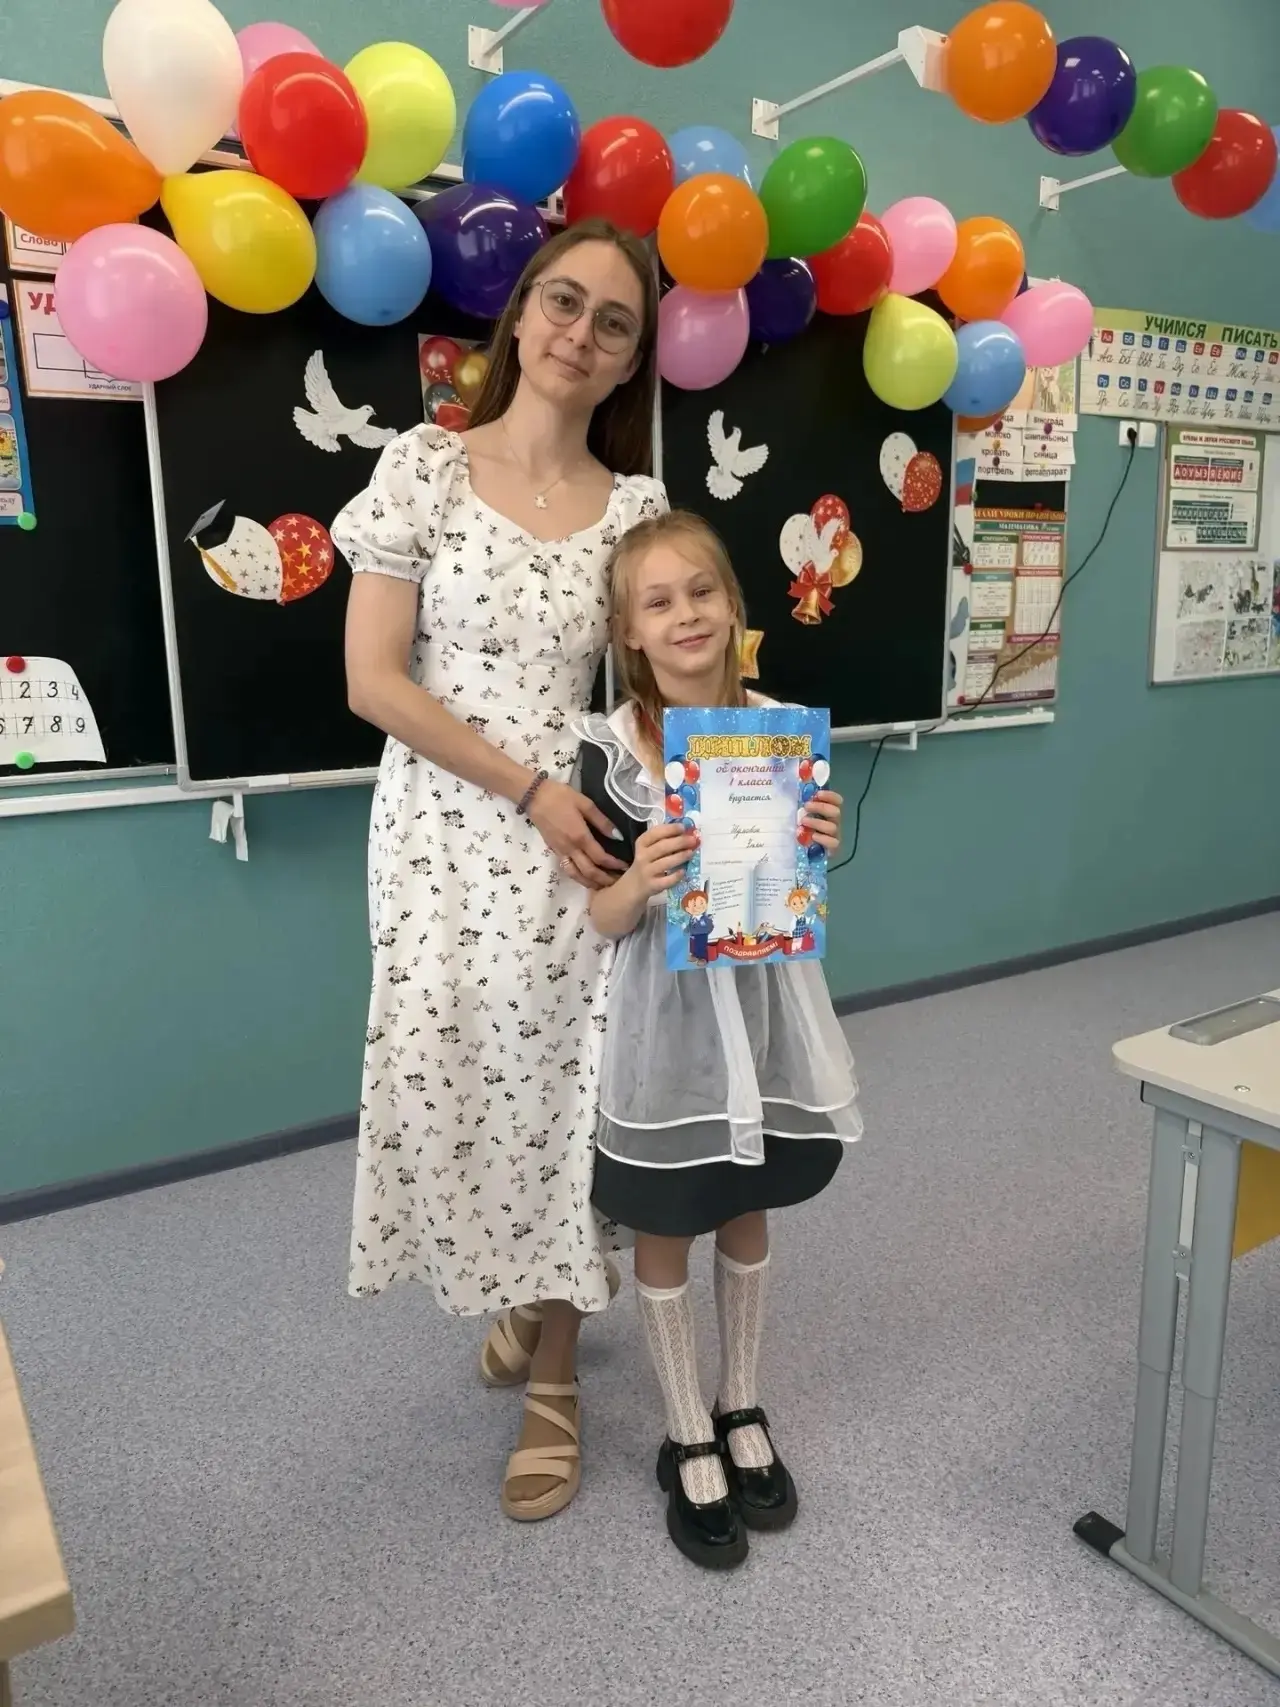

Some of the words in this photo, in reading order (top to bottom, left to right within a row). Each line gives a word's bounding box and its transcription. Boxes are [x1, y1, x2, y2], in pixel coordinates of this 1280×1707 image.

[1144, 315, 1207, 339] УЧИМСЯ
[1221, 327, 1278, 349] ПИСАТЬ
[20, 681, 31, 698] 2
[47, 681, 58, 698] 3
[72, 685, 79, 700] 4
[22, 716, 34, 734] 7
[50, 715, 62, 733] 8
[75, 717, 85, 733] 9
[687, 736, 811, 759] ДИПЛОМ
[716, 762, 728, 773] об
[730, 764, 785, 773] окончании
[737, 778, 773, 786] класса
[728, 793, 771, 804] вручается
[723, 941, 779, 957] ПОЗДРАВЛЯЕМ!
